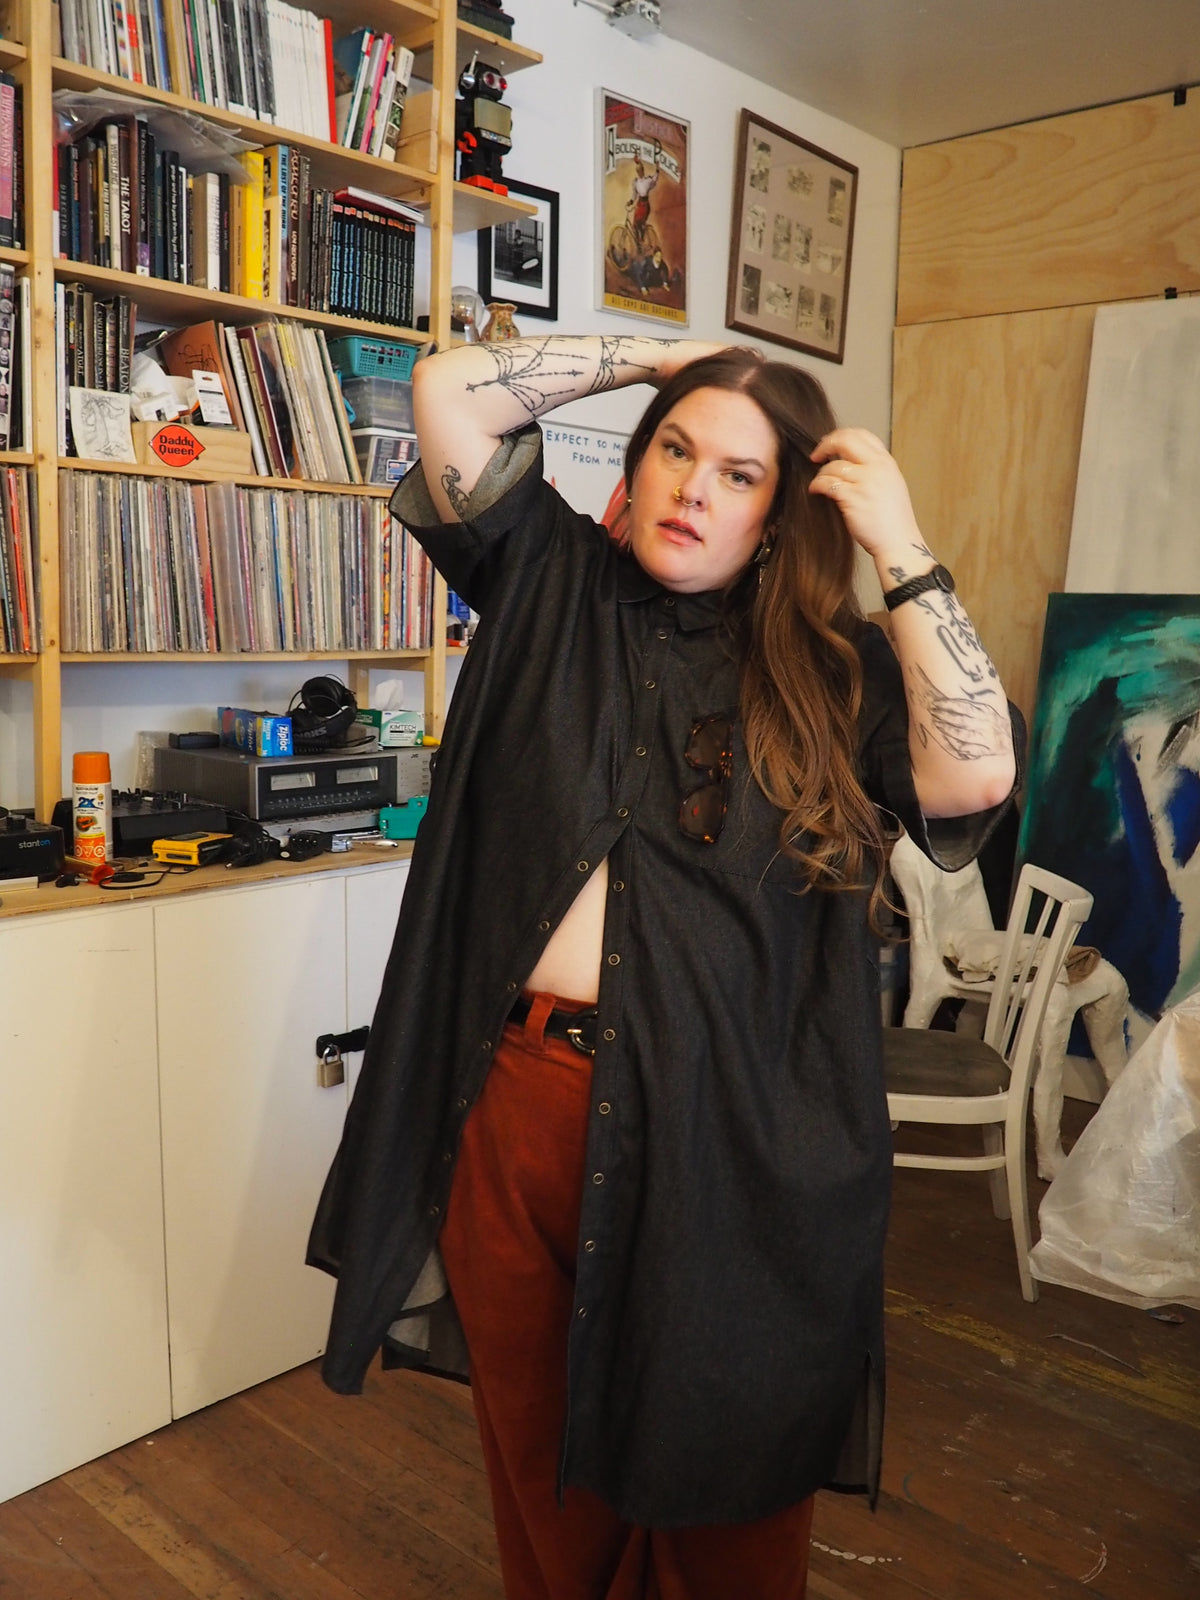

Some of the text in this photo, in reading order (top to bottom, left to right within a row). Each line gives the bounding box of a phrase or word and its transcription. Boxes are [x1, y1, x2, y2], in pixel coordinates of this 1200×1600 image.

[121, 177, 131, 235] THE TAROT
[120, 347, 130, 392] BEATON
[159, 434, 194, 449] Daddy
[546, 430, 589, 446] EXPECT
[596, 440, 607, 449] SO
[159, 444, 194, 456] Queen
[573, 452, 622, 466] FROM ME
[277, 726, 289, 752] Ziploc
[78, 797, 96, 808] 2X
[18, 839, 51, 849] stanton
